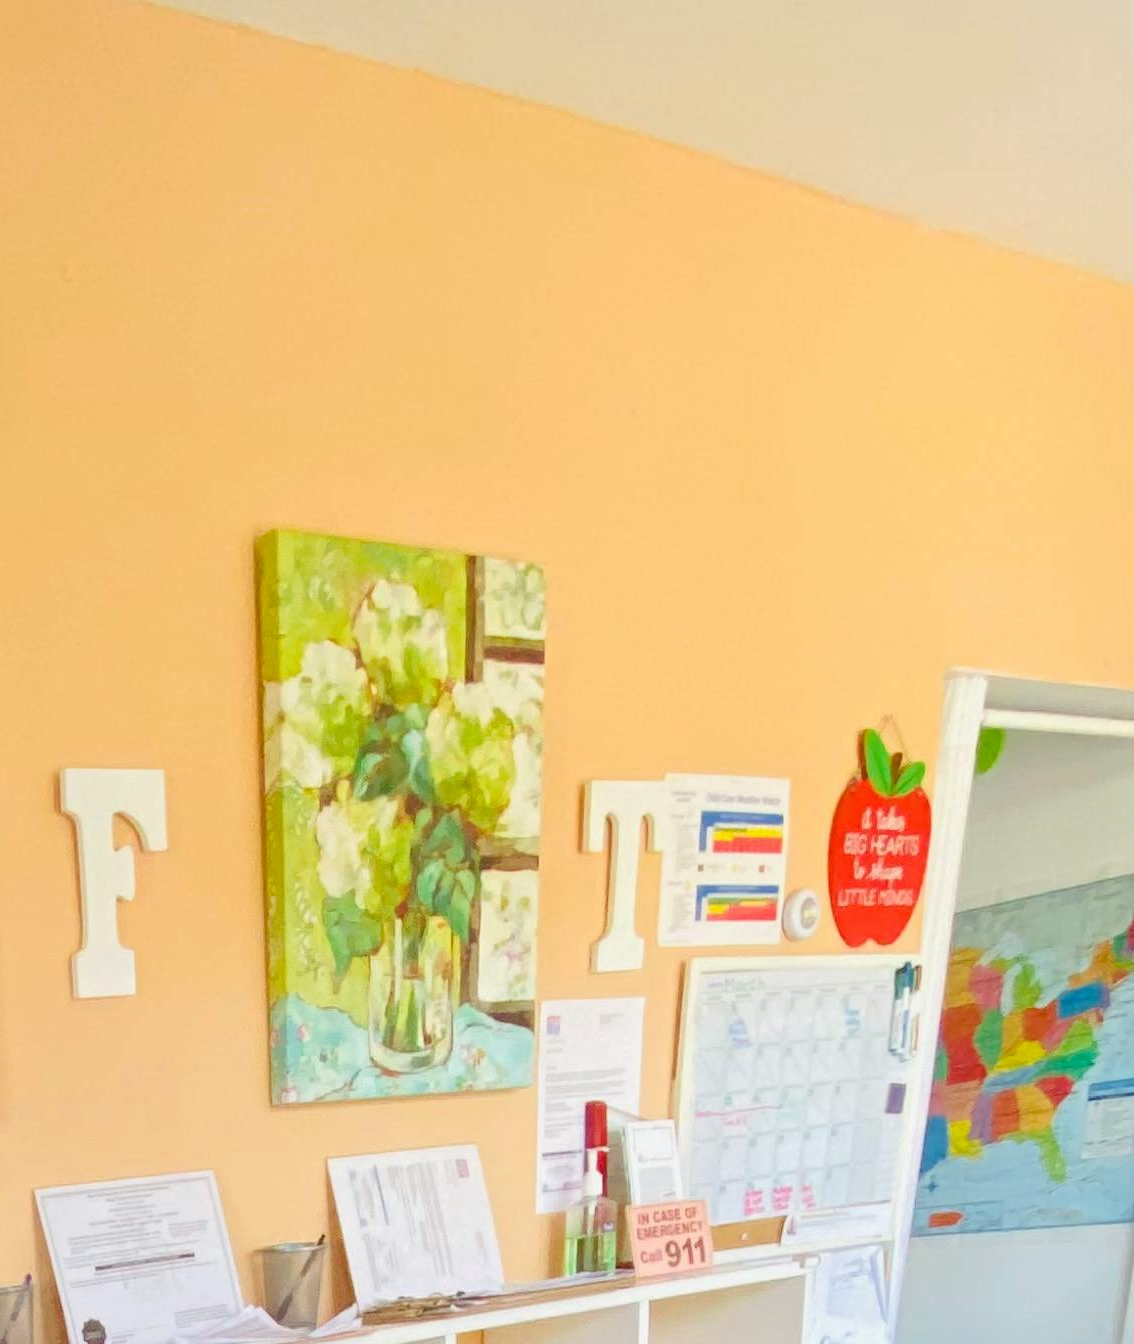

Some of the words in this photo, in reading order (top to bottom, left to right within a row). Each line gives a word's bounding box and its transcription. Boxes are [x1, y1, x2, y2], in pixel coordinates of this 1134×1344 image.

[869, 834, 921, 857] HEARTS
[59, 768, 168, 998] F
[582, 780, 667, 973] T
[637, 1213, 649, 1225] IN
[653, 1208, 681, 1223] CASE
[685, 1207, 697, 1219] OF
[636, 1221, 703, 1240] EMERGENCY
[640, 1248, 663, 1263] Call
[665, 1235, 706, 1268] 911
